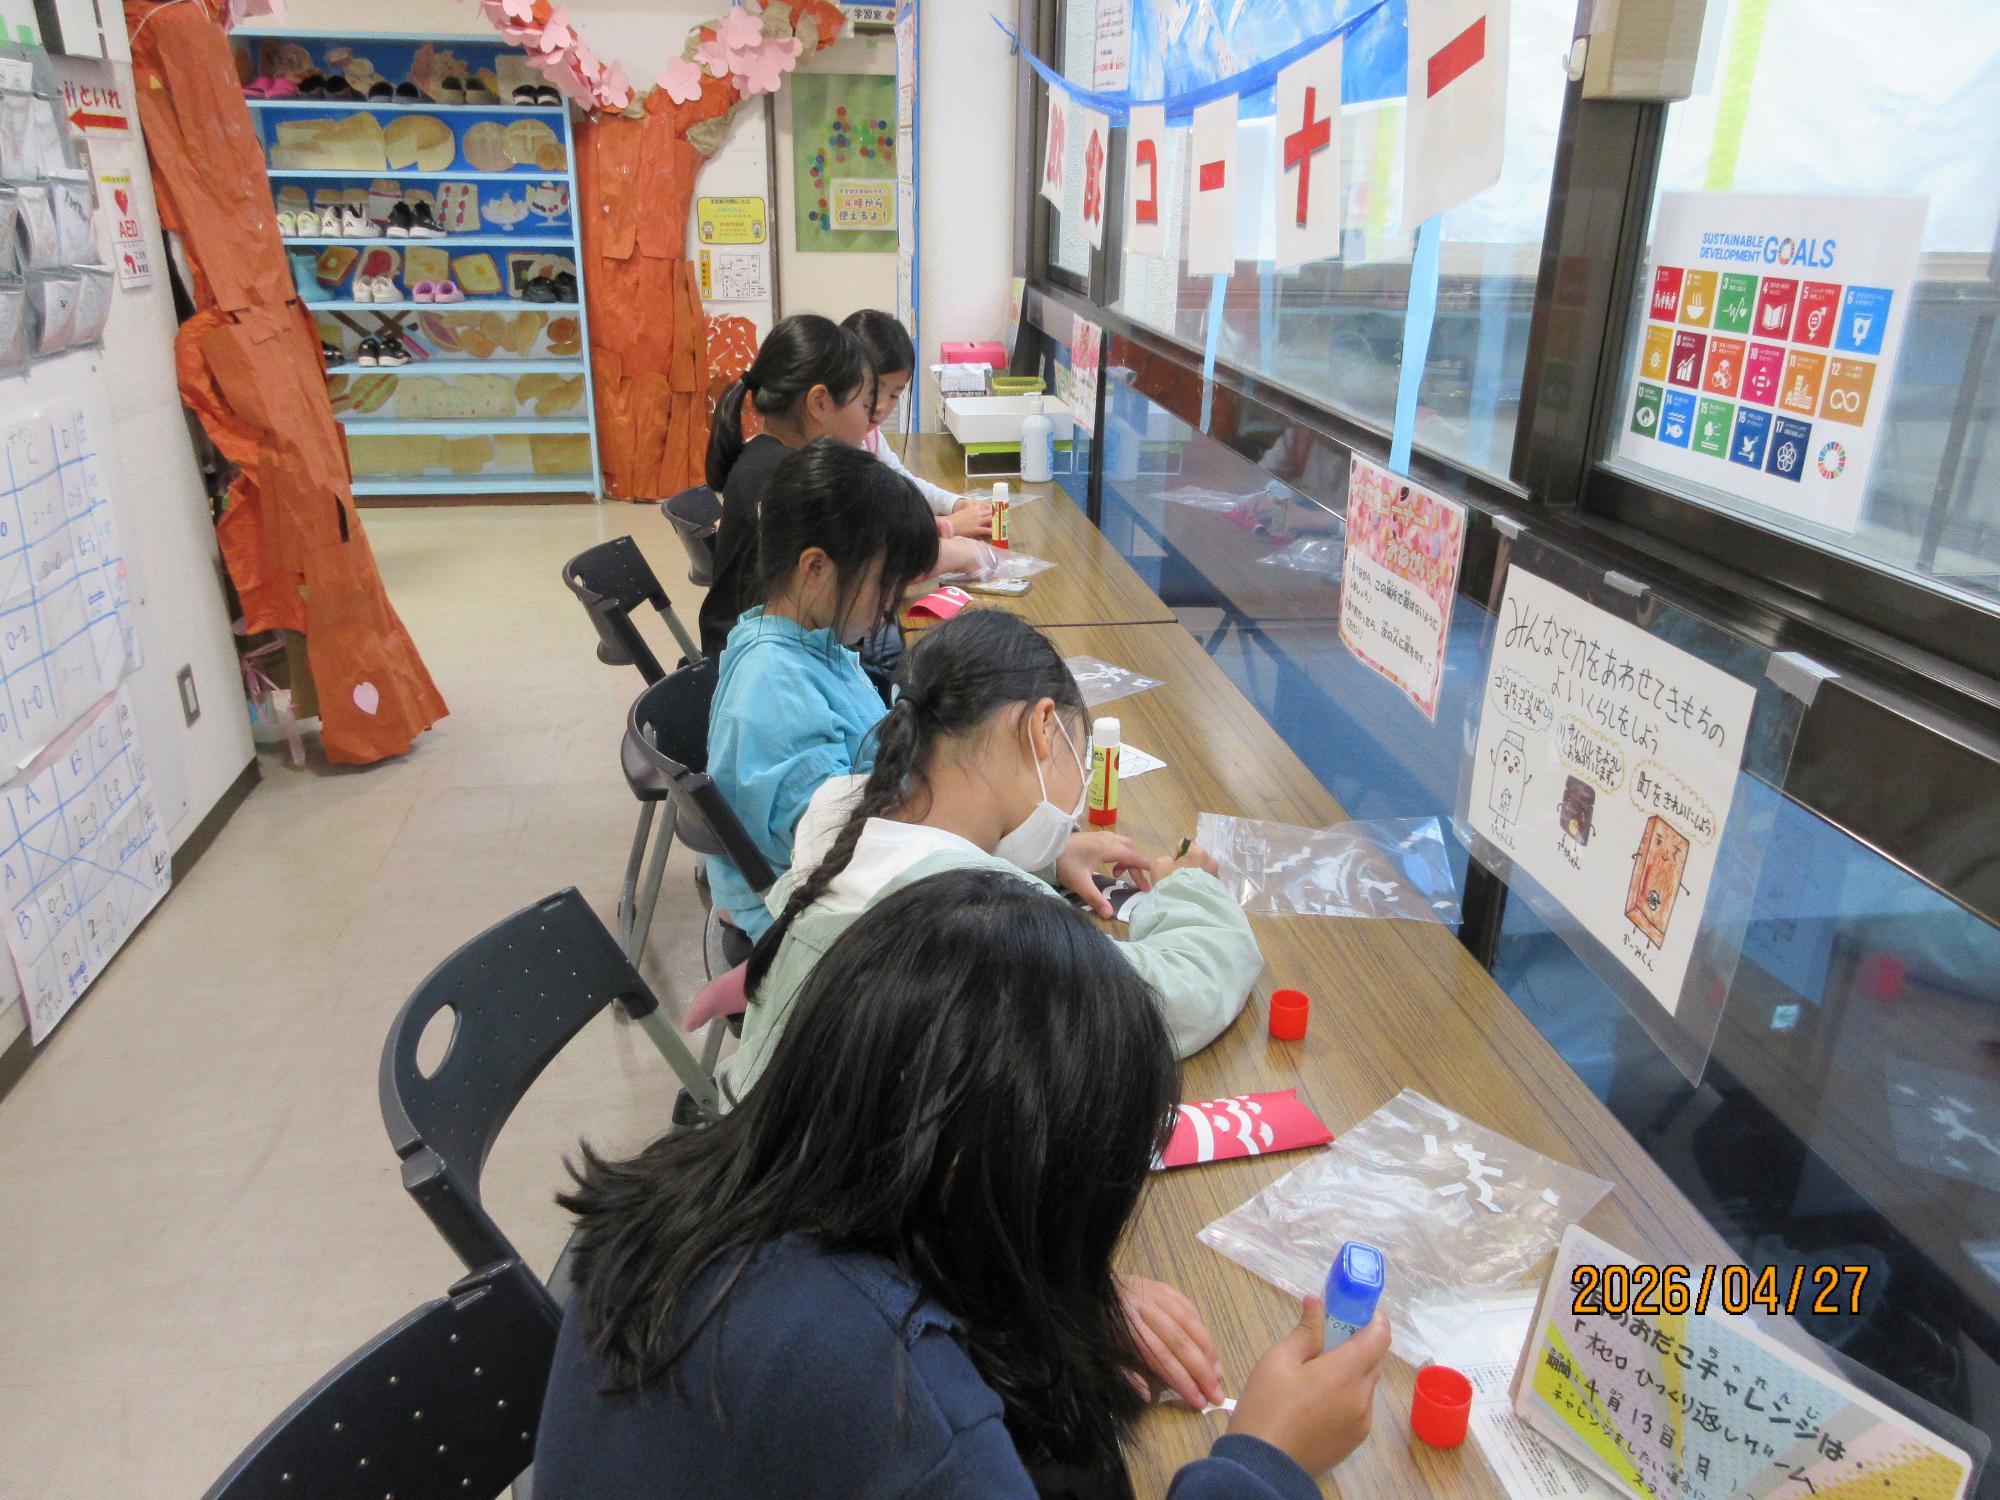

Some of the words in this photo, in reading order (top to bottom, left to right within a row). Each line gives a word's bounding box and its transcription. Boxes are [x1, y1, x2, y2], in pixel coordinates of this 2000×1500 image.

[853, 7, 882, 20] 学習室
[79, 85, 123, 110] といれ
[119, 219, 139, 239] AED
[1702, 232, 1764, 248] SUSTAINABLE
[1699, 246, 1761, 263] DEVELOPMENT
[1763, 235, 1837, 269] GOALS
[1504, 597, 1726, 749] みんなで力をあわせてきもちの
[24, 783, 41, 815] A
[1636, 770, 1712, 838] 町をきれいにしよう
[4, 863, 17, 891] A
[16, 911, 33, 941] B
